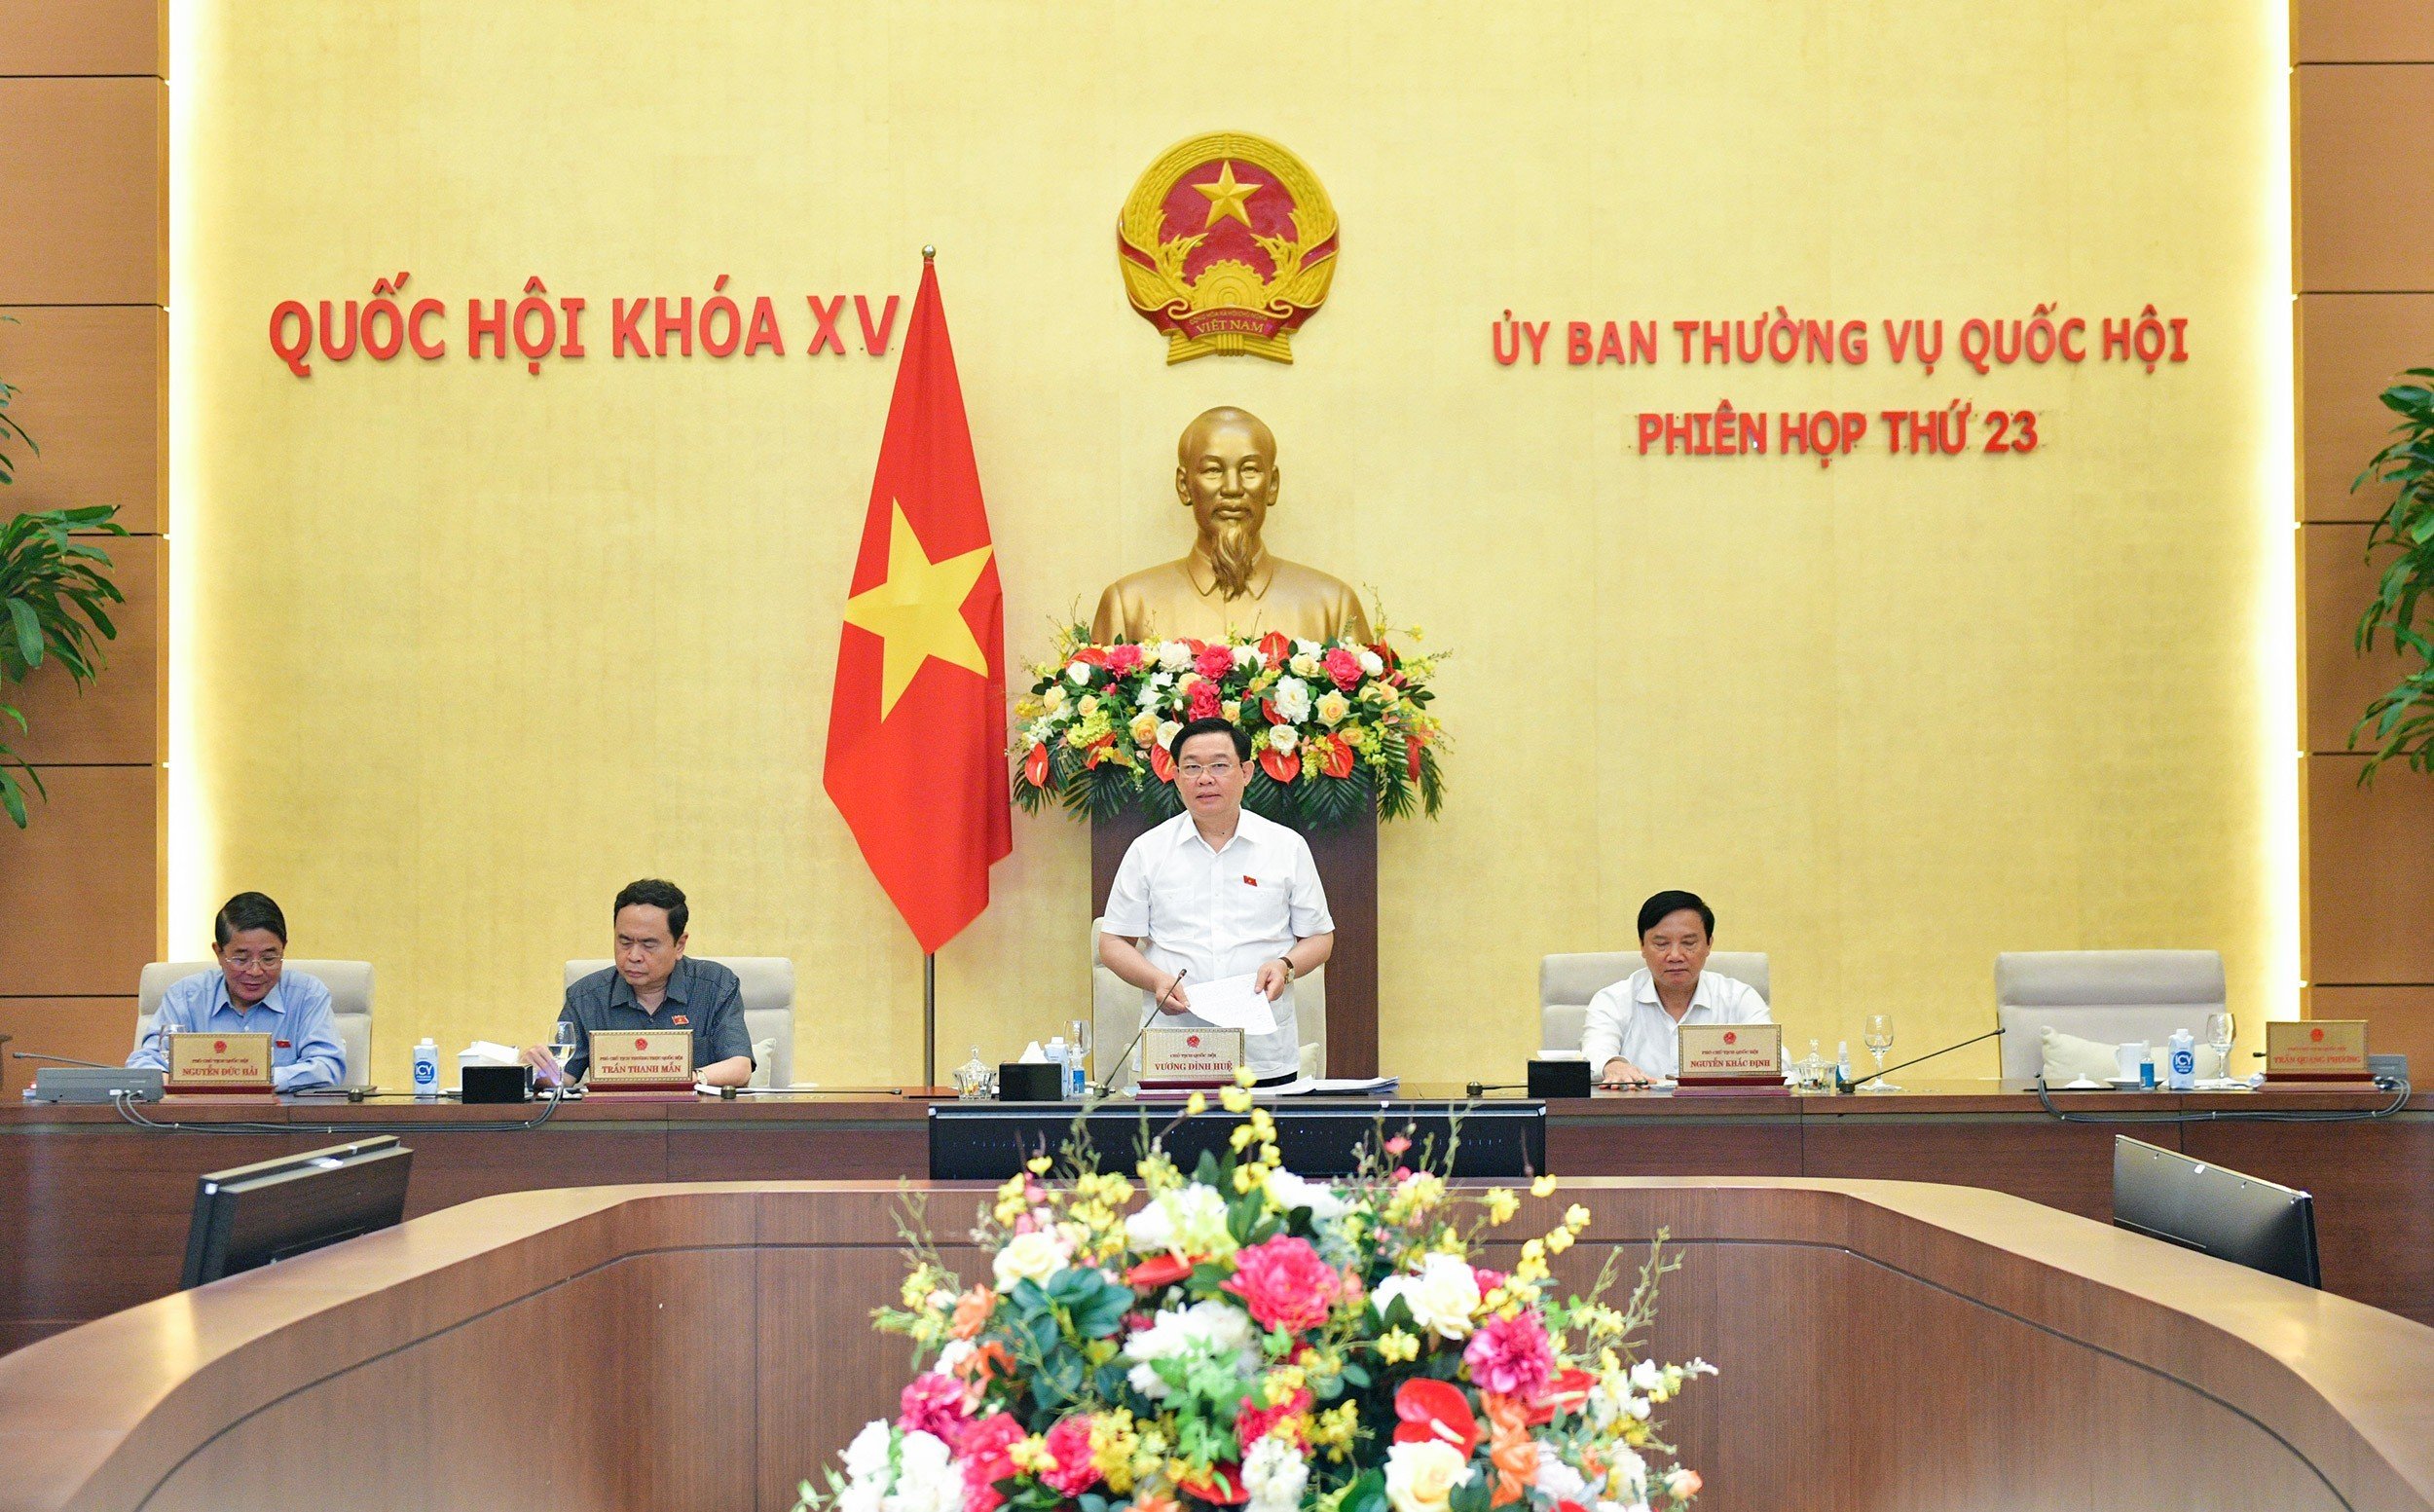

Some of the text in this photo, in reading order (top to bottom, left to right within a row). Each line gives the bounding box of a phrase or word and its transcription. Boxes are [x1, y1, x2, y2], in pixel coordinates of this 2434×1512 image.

[269, 272, 901, 377] QUỐC HỘI KHÓA XV
[1229, 319, 1264, 333] NAM
[1493, 303, 2190, 375] ỦY BAN THƯỜNG VỤ QUỐC HỘI
[1639, 398, 2039, 468] PHIÊN HỌP THỨ 23
[416, 1064, 433, 1076] ICY
[2175, 1054, 2192, 1066] ICY
